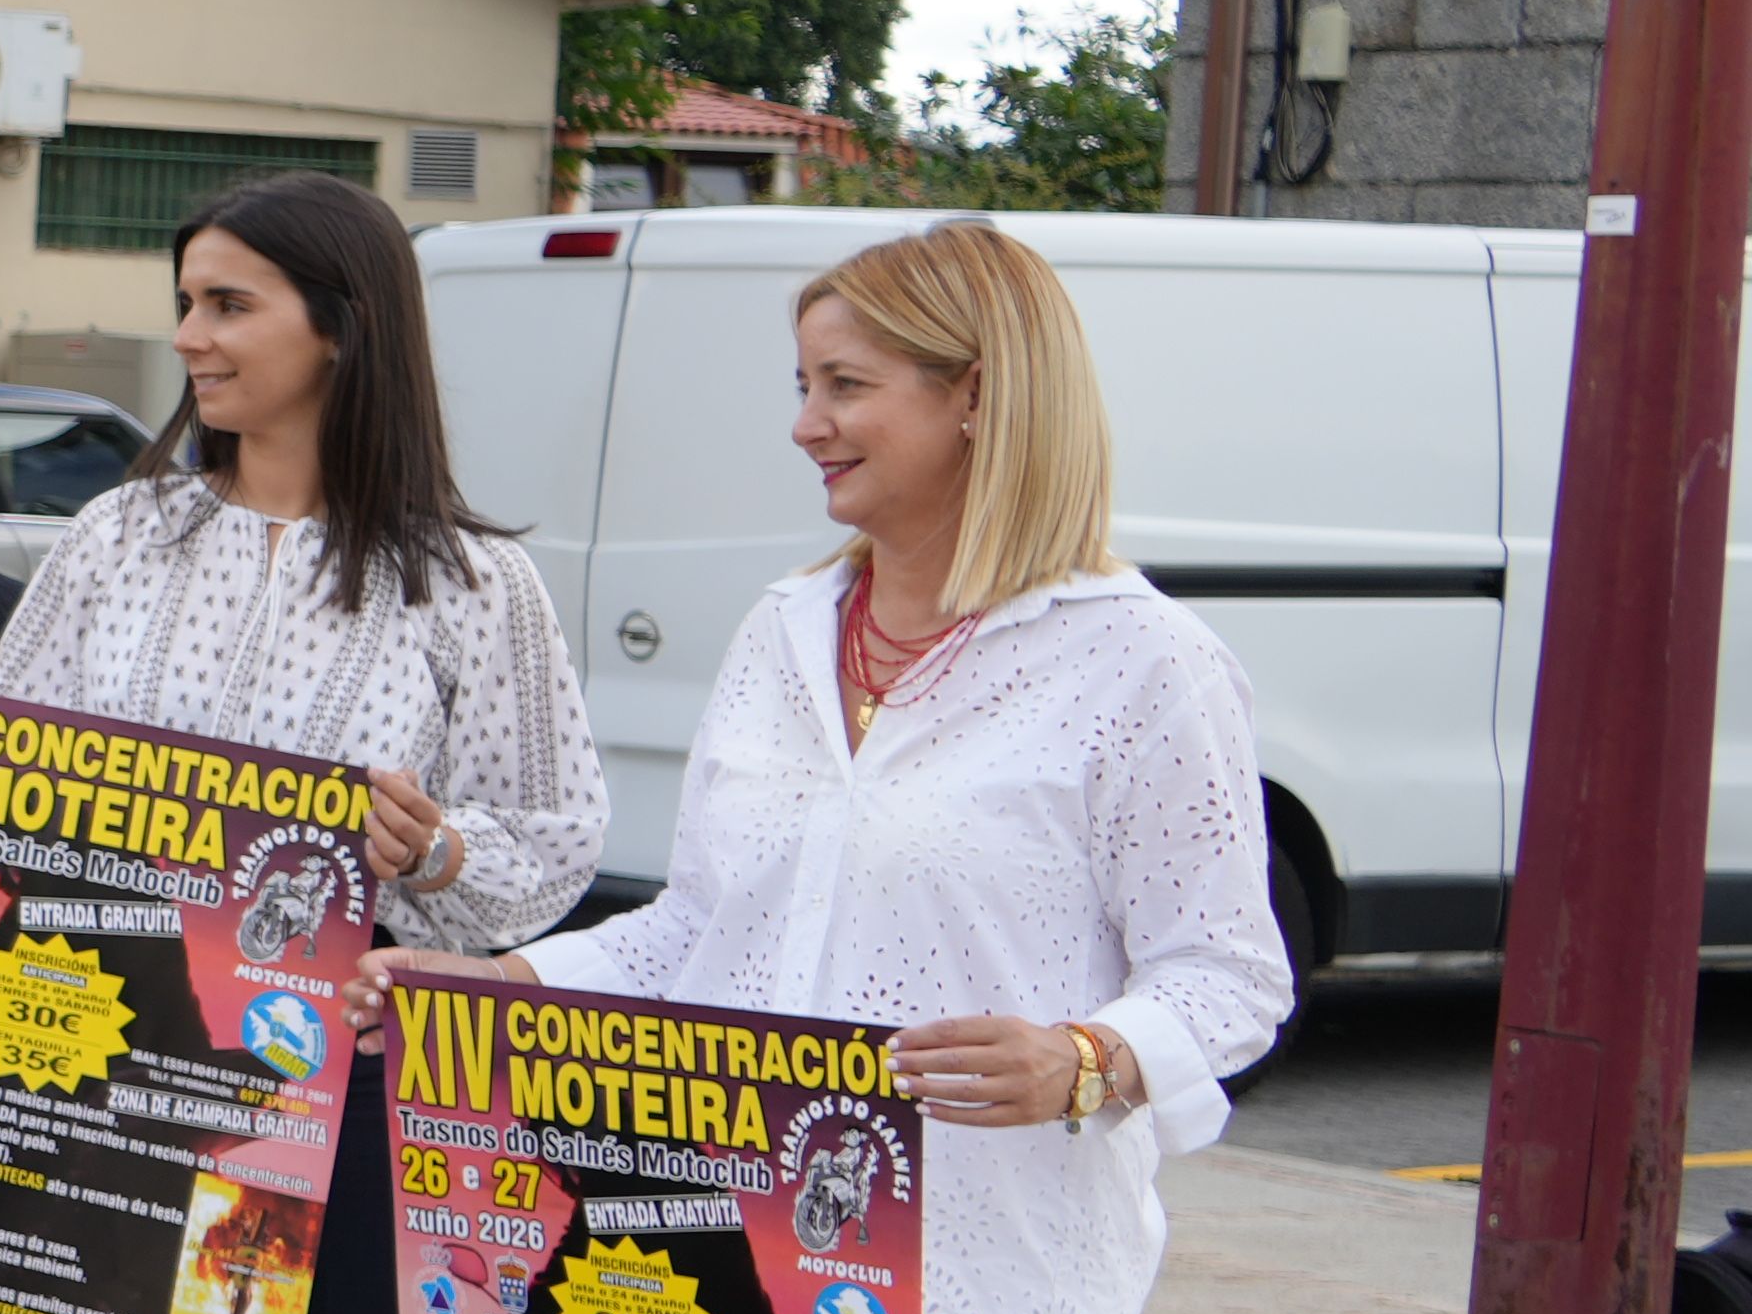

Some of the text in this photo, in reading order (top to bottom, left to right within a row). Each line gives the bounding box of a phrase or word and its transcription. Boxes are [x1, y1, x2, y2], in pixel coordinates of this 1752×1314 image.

[86, 850, 222, 907] Motoclub
[393, 986, 495, 1112] XIV
[509, 1056, 770, 1152] MOTEIRA
[398, 1109, 772, 1194] Trasnos do Salnés Motoclub
[400, 1145, 542, 1210] 26 e 27
[404, 1202, 543, 1252] xuño 2026
